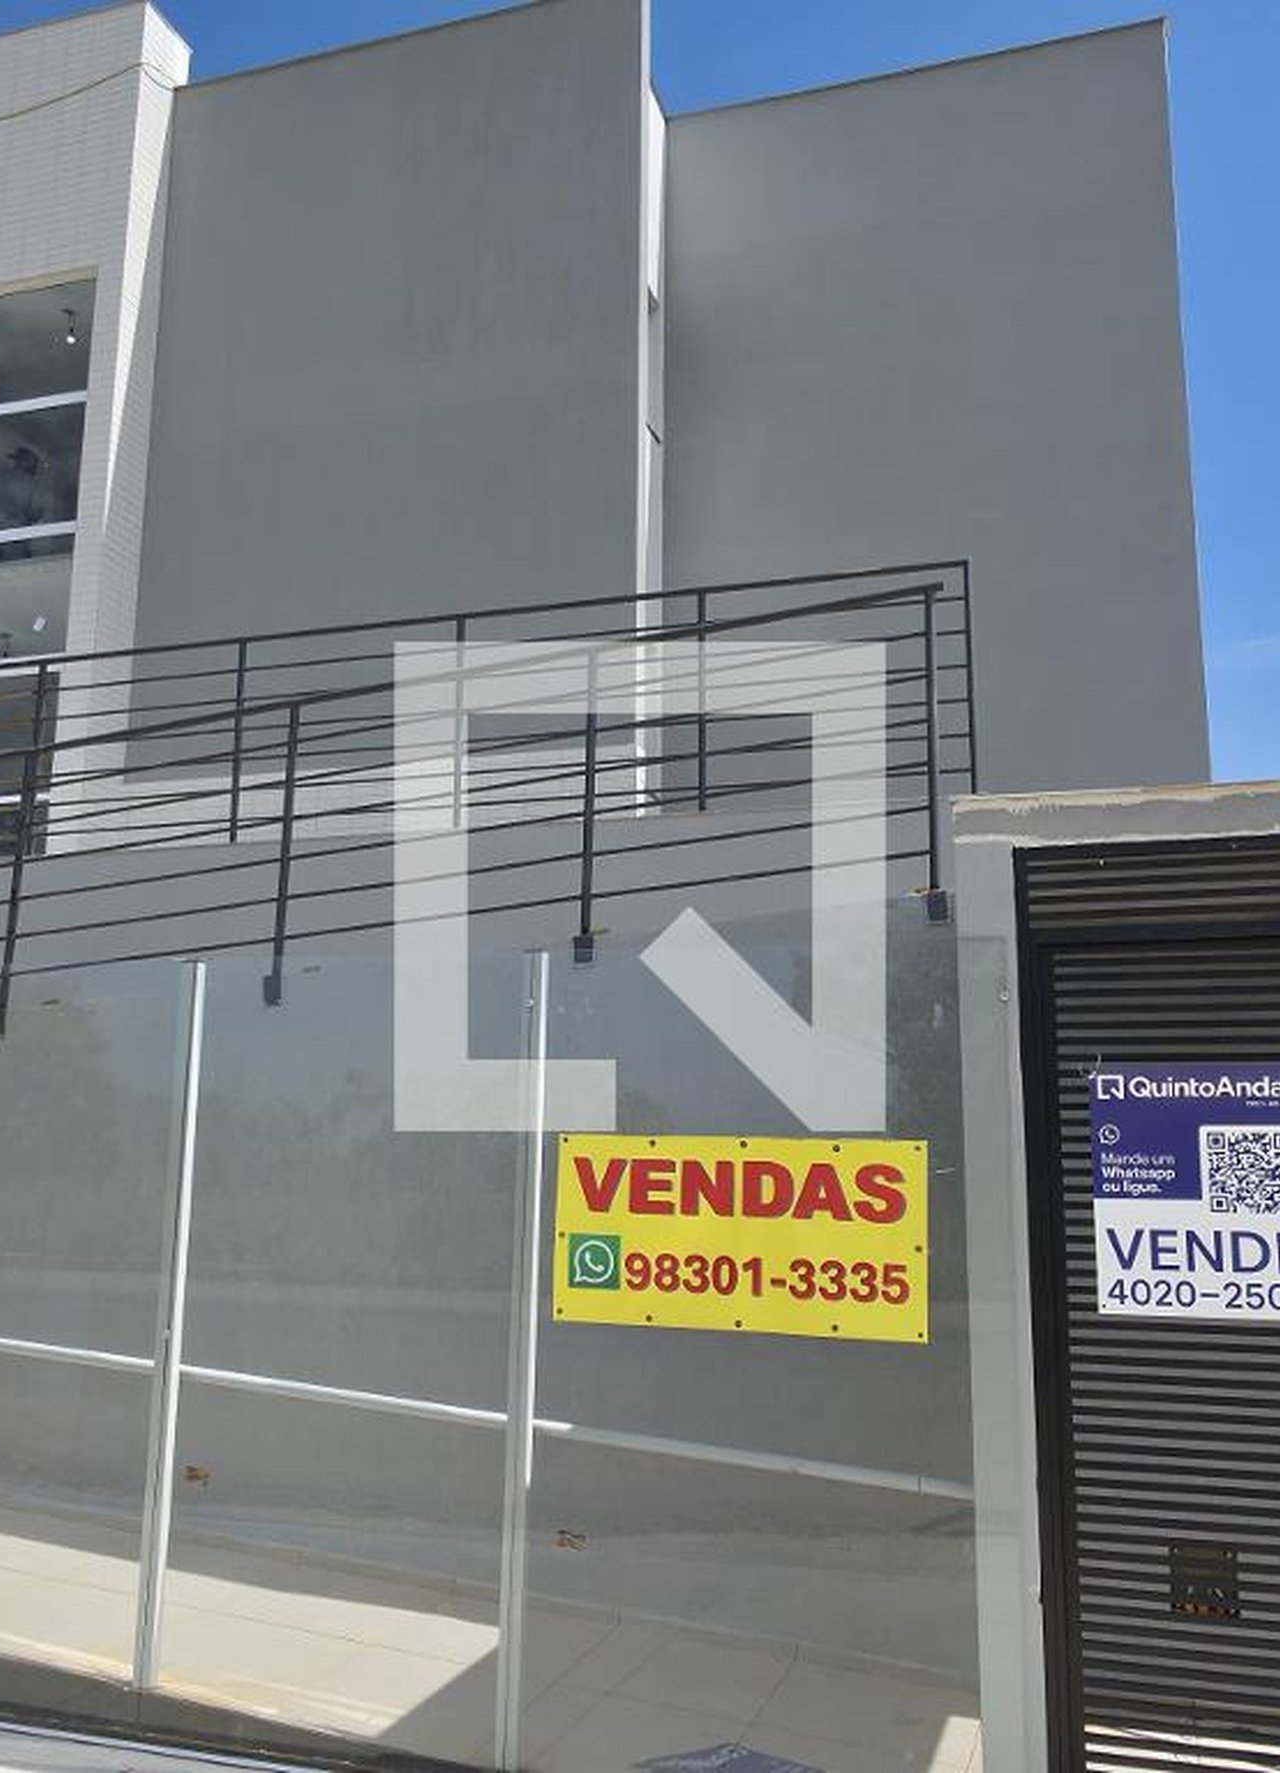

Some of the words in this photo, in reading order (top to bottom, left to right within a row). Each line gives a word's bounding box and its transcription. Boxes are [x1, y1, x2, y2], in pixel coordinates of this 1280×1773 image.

[573, 1157, 907, 1223] VENDAS
[1102, 1183, 1121, 1193] ou
[624, 1252, 910, 1304] 98301-3335
